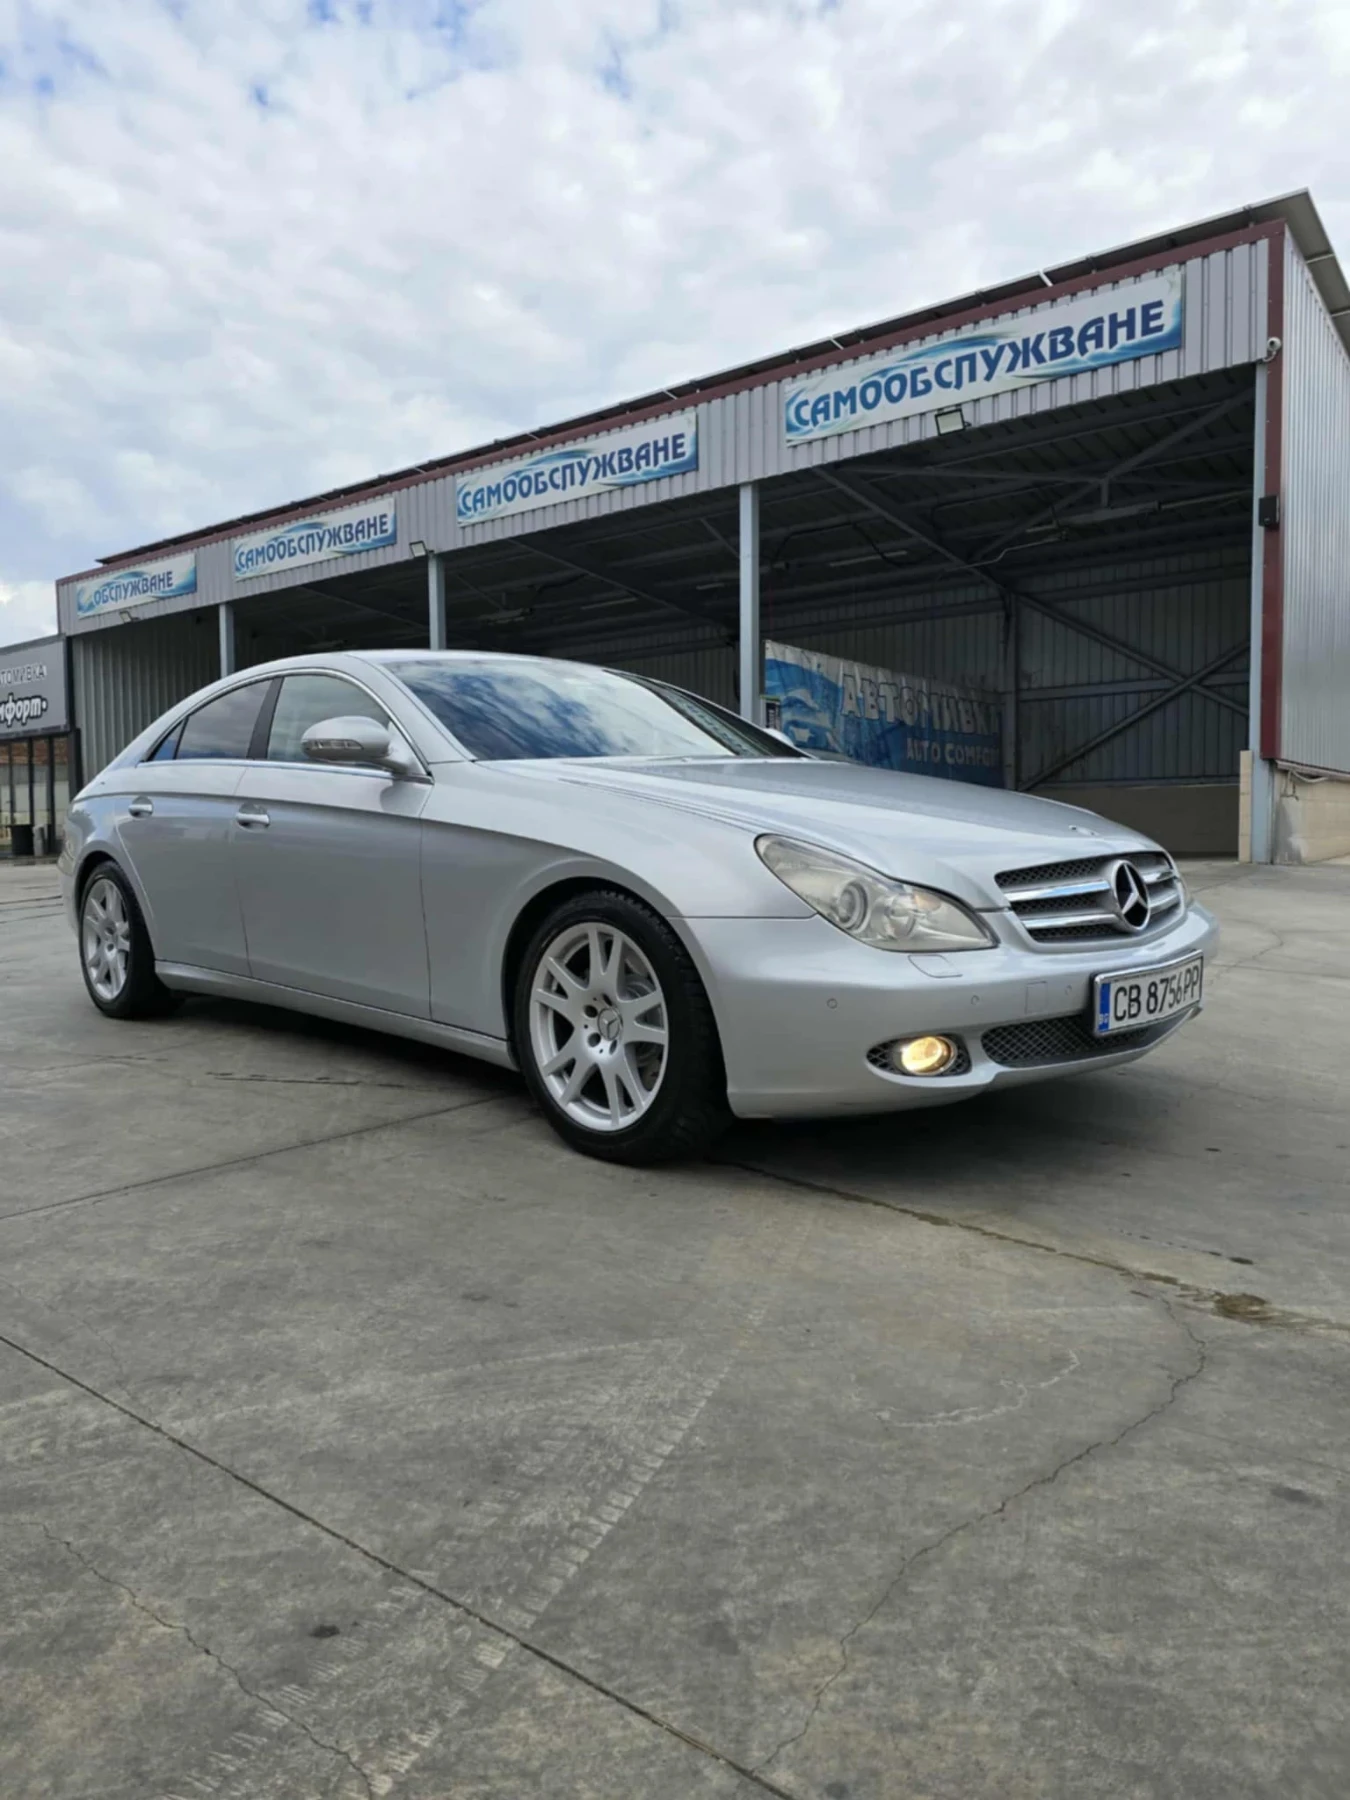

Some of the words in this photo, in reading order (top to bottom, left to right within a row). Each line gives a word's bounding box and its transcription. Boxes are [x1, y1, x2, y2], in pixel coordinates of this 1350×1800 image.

[795, 299, 1164, 428] САМООБСЛУЖВАНЕ
[462, 433, 686, 514] САМООБСЛУЖВАНЕ
[238, 513, 389, 570] САМООБСЛУЖВАНЕ
[93, 571, 174, 605] ОБСЛУЖВАНЕ
[0, 663, 47, 686] ТОМИВКА
